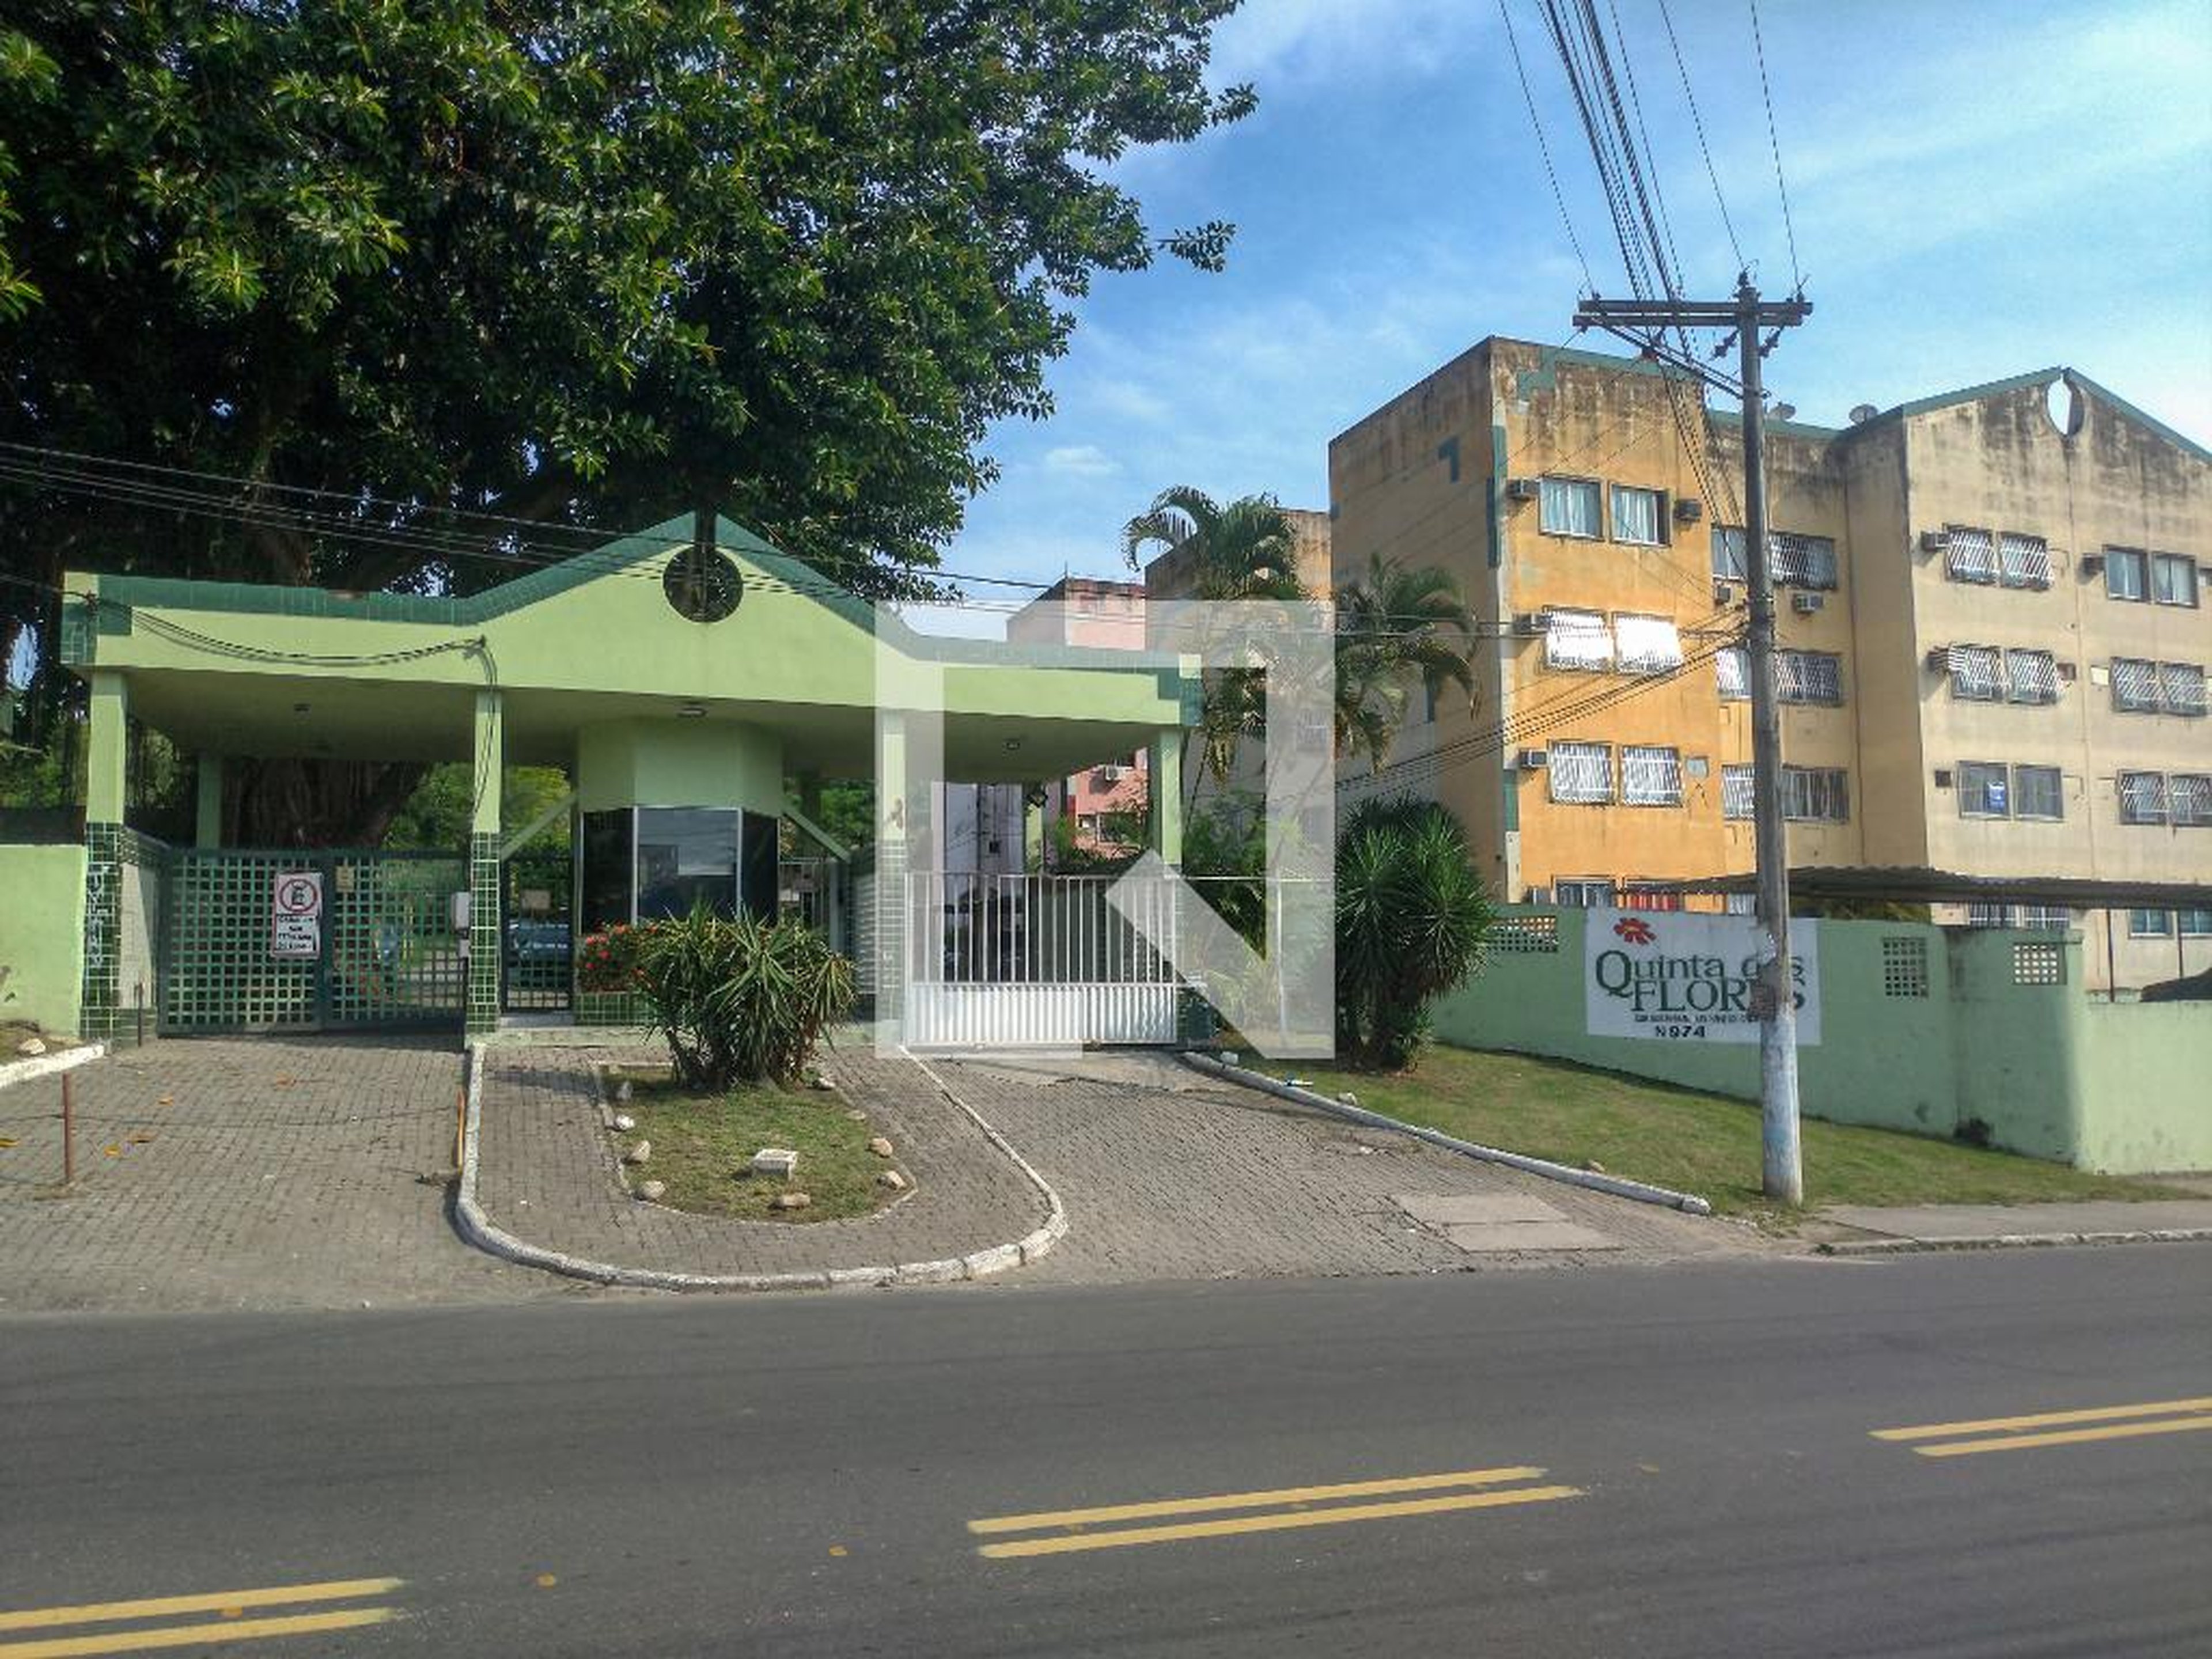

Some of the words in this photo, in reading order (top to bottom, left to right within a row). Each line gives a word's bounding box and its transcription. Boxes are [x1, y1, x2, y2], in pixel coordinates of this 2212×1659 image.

[1596, 950, 1724, 998] Quinta
[1741, 952, 1804, 978] ds
[1631, 978, 1806, 1012] FLORS
